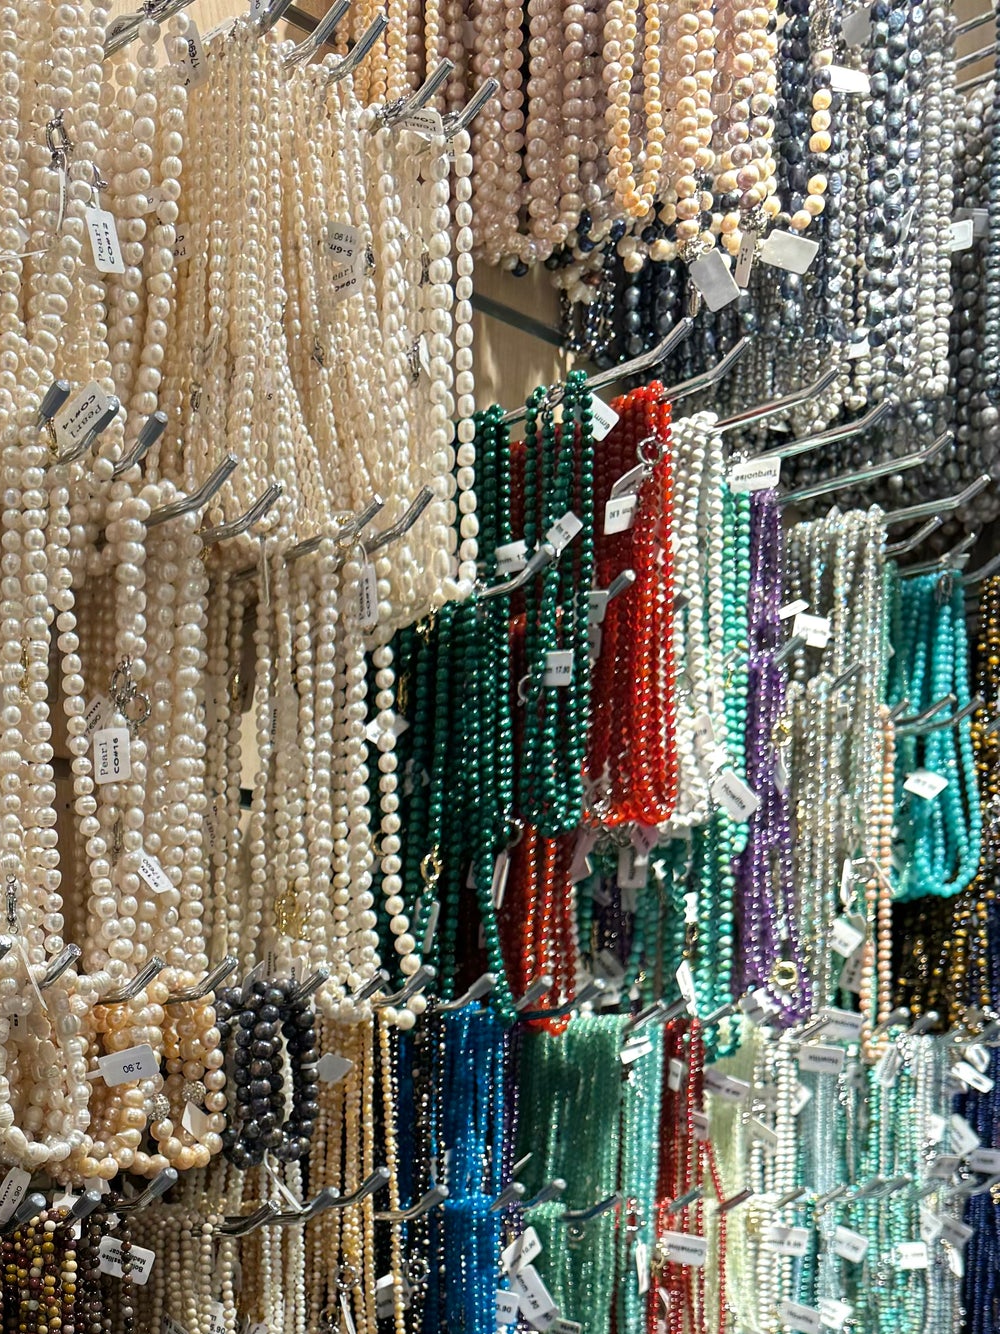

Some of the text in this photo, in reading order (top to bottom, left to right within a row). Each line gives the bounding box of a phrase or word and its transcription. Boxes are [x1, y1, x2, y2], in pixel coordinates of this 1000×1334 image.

[332, 265, 354, 281] earl
[99, 741, 109, 777] Pearl
[122, 1061, 143, 1074] 2.90
[12, 1185, 23, 1206] 4.90
